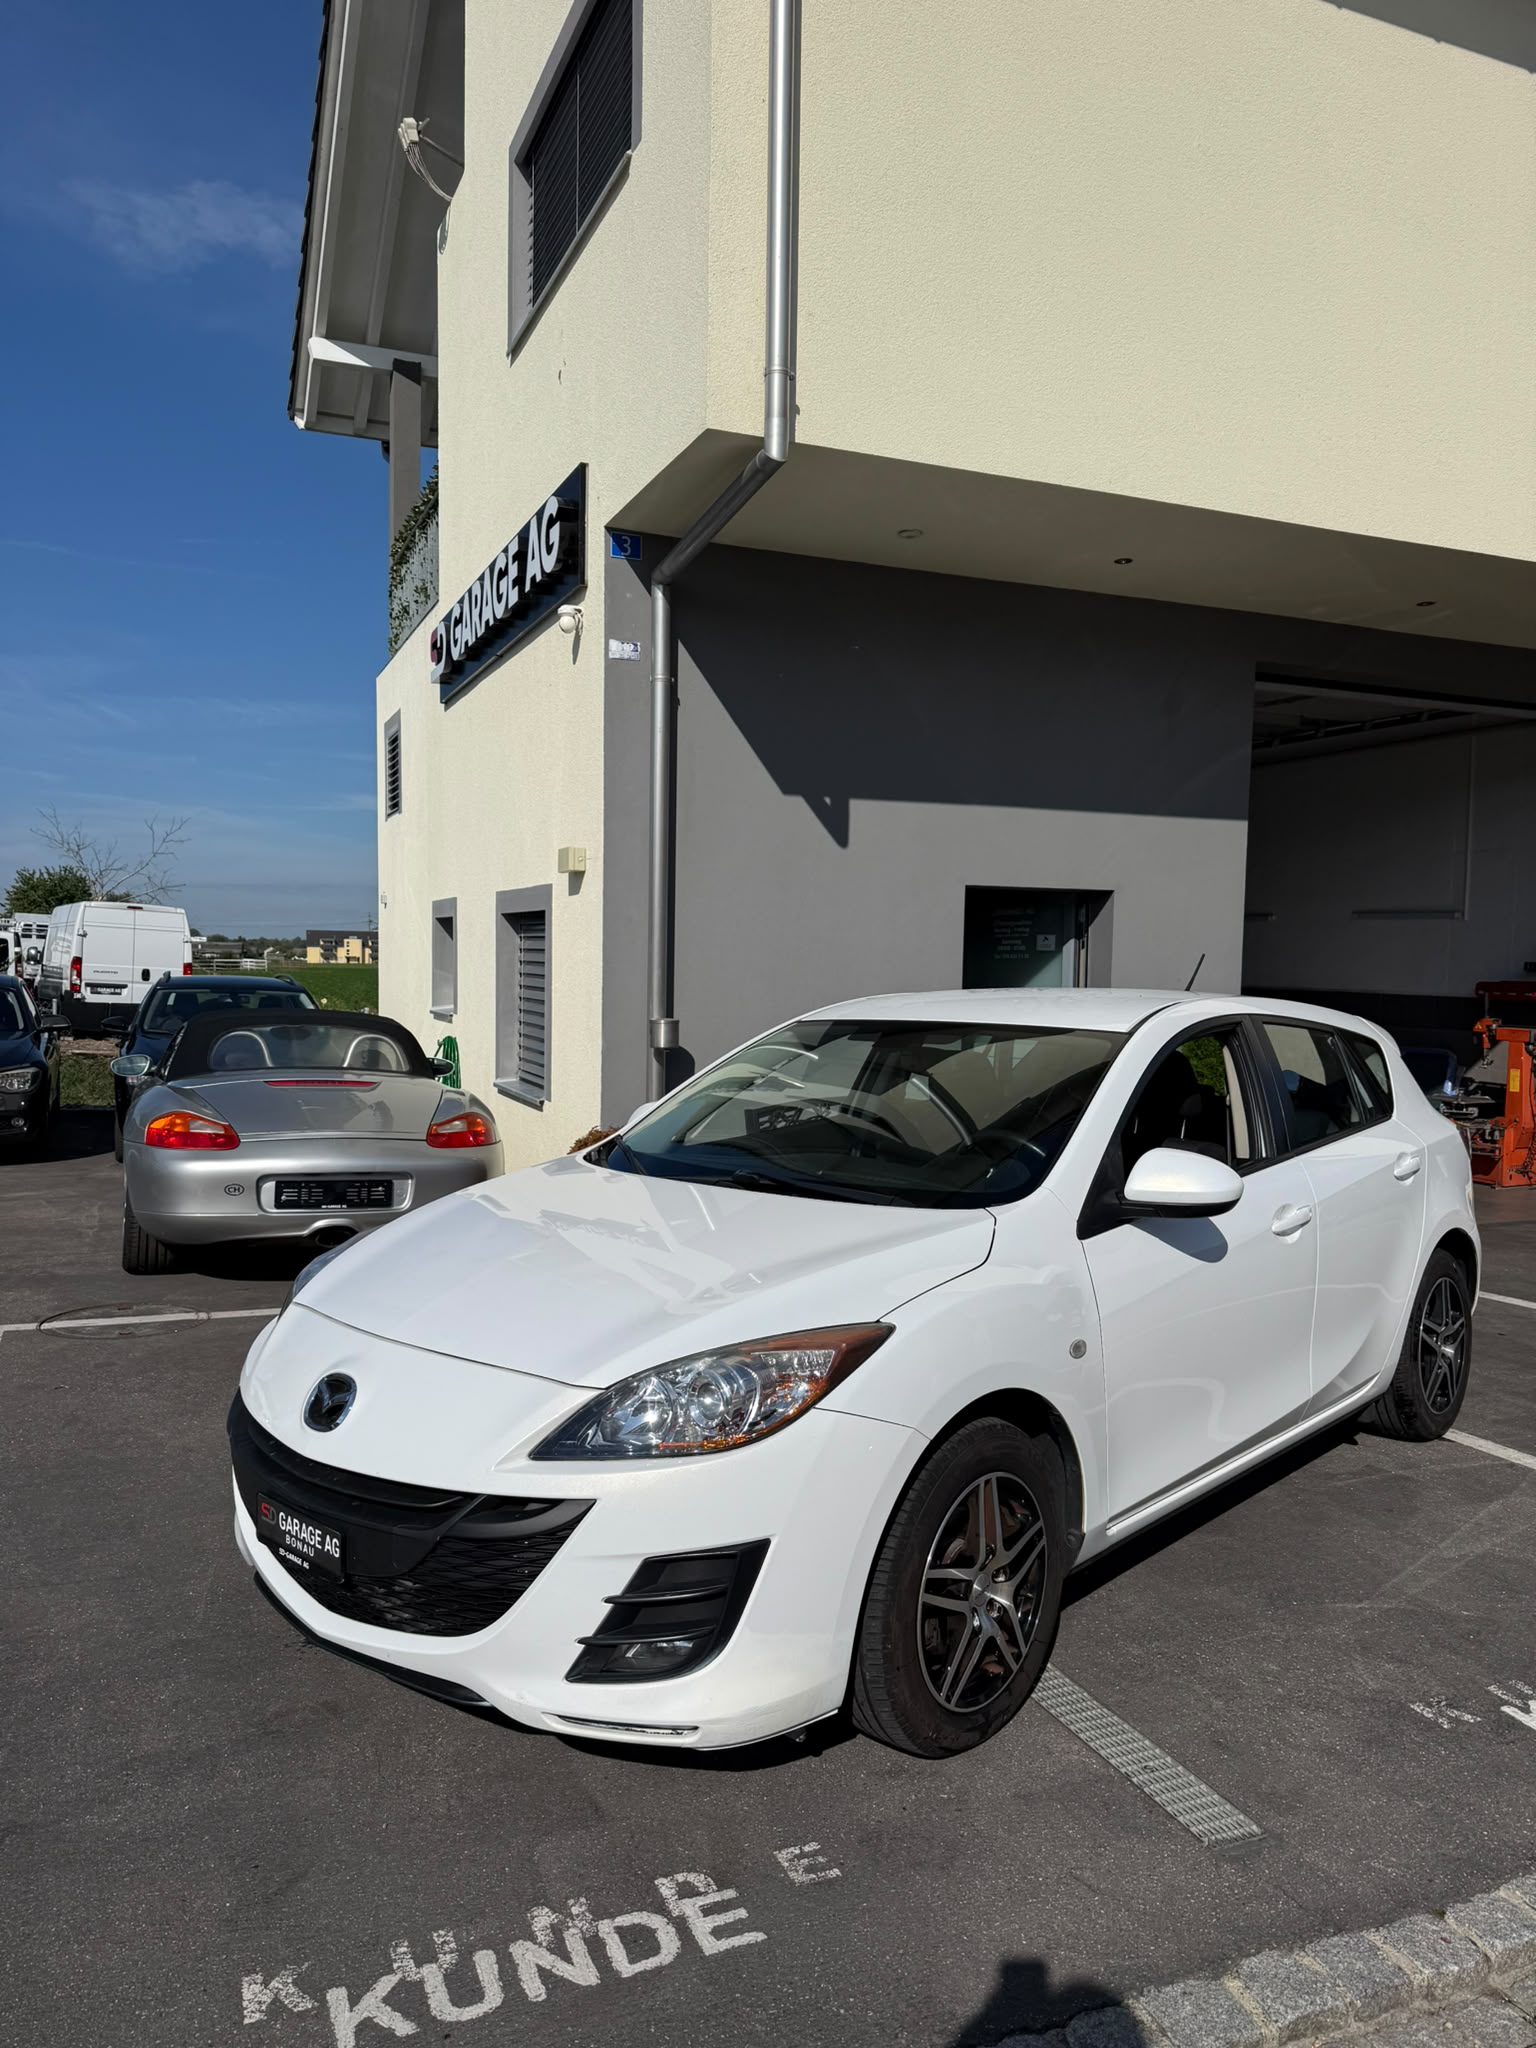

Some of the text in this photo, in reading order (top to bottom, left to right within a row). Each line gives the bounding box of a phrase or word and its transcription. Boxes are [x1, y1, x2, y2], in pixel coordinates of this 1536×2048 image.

[621, 535, 632, 556] 3
[449, 535, 519, 661] GARAGE
[525, 495, 561, 593] AG
[227, 1186, 241, 1194] CH
[279, 1511, 322, 1550] GARAGE
[324, 1534, 340, 1558] AG
[285, 1534, 315, 1557] BONAU
[326, 1887, 768, 2048] KUNDE
